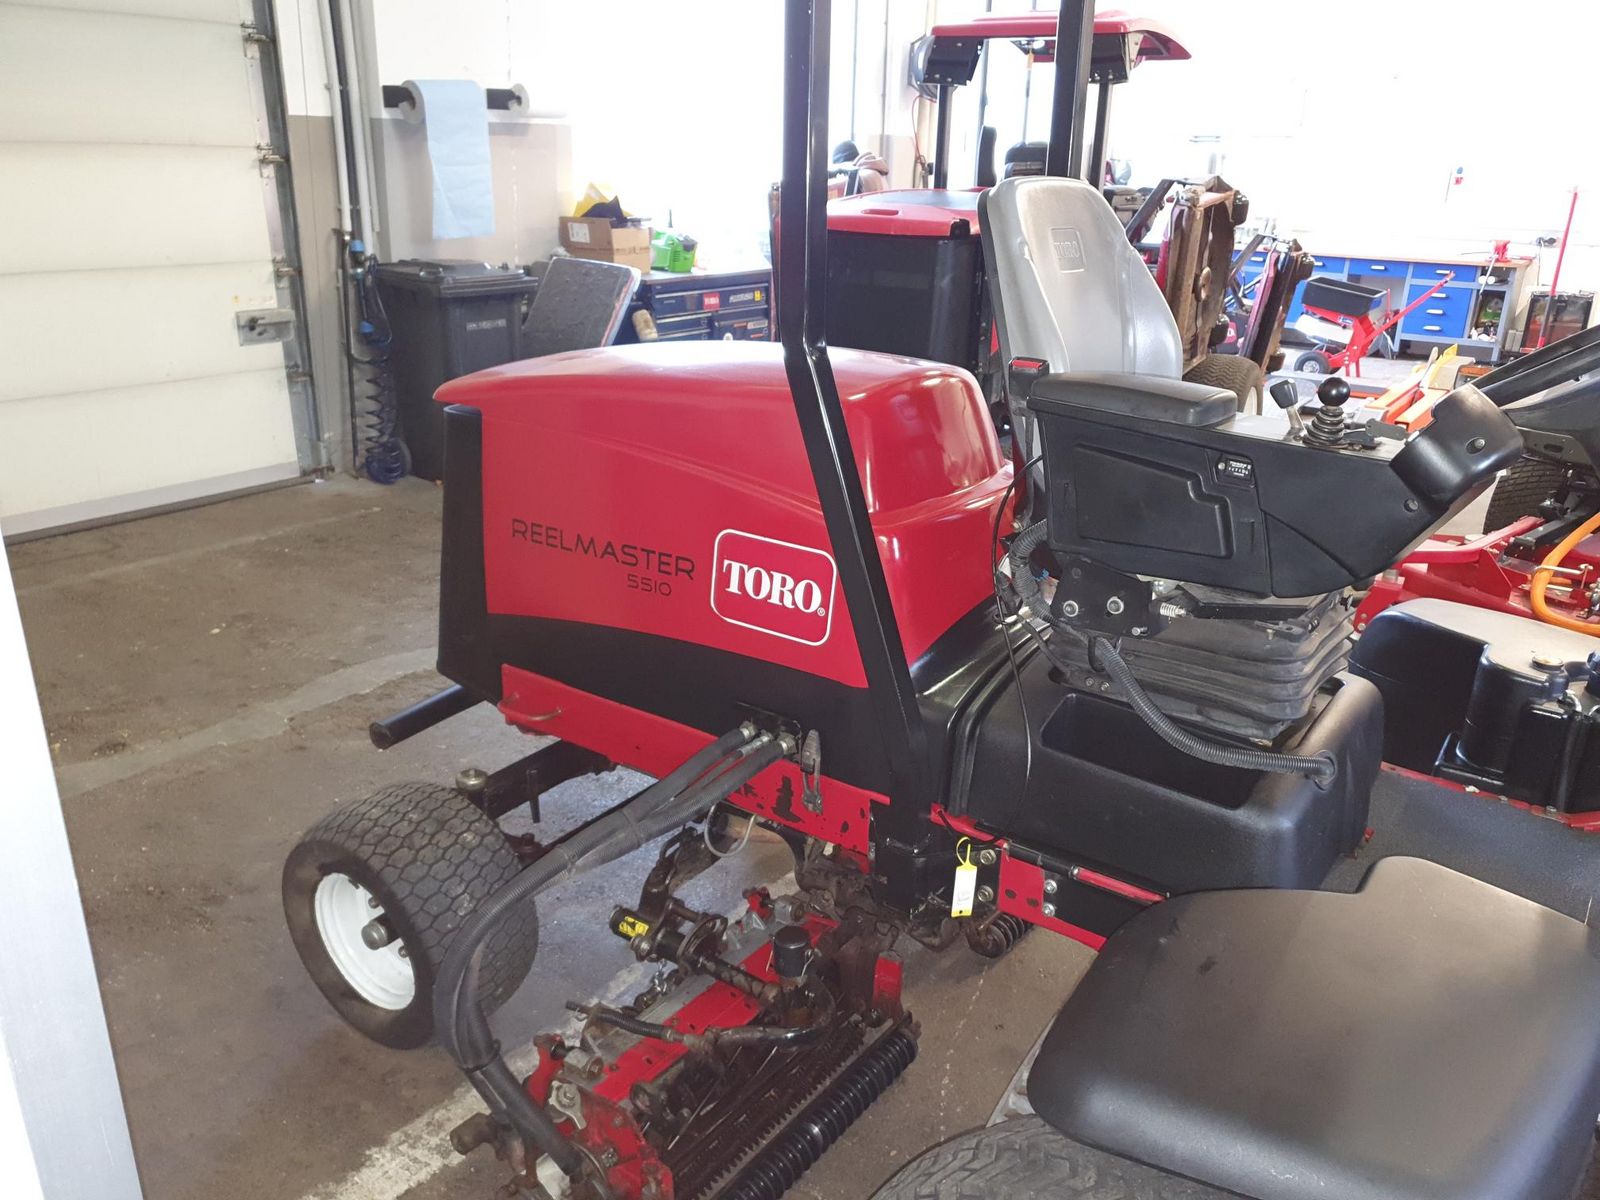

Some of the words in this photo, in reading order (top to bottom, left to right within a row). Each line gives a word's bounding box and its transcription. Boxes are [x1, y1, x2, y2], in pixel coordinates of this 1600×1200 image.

[512, 518, 696, 580] REELMASTER
[627, 573, 672, 597] 5510
[722, 558, 823, 615] TORO
